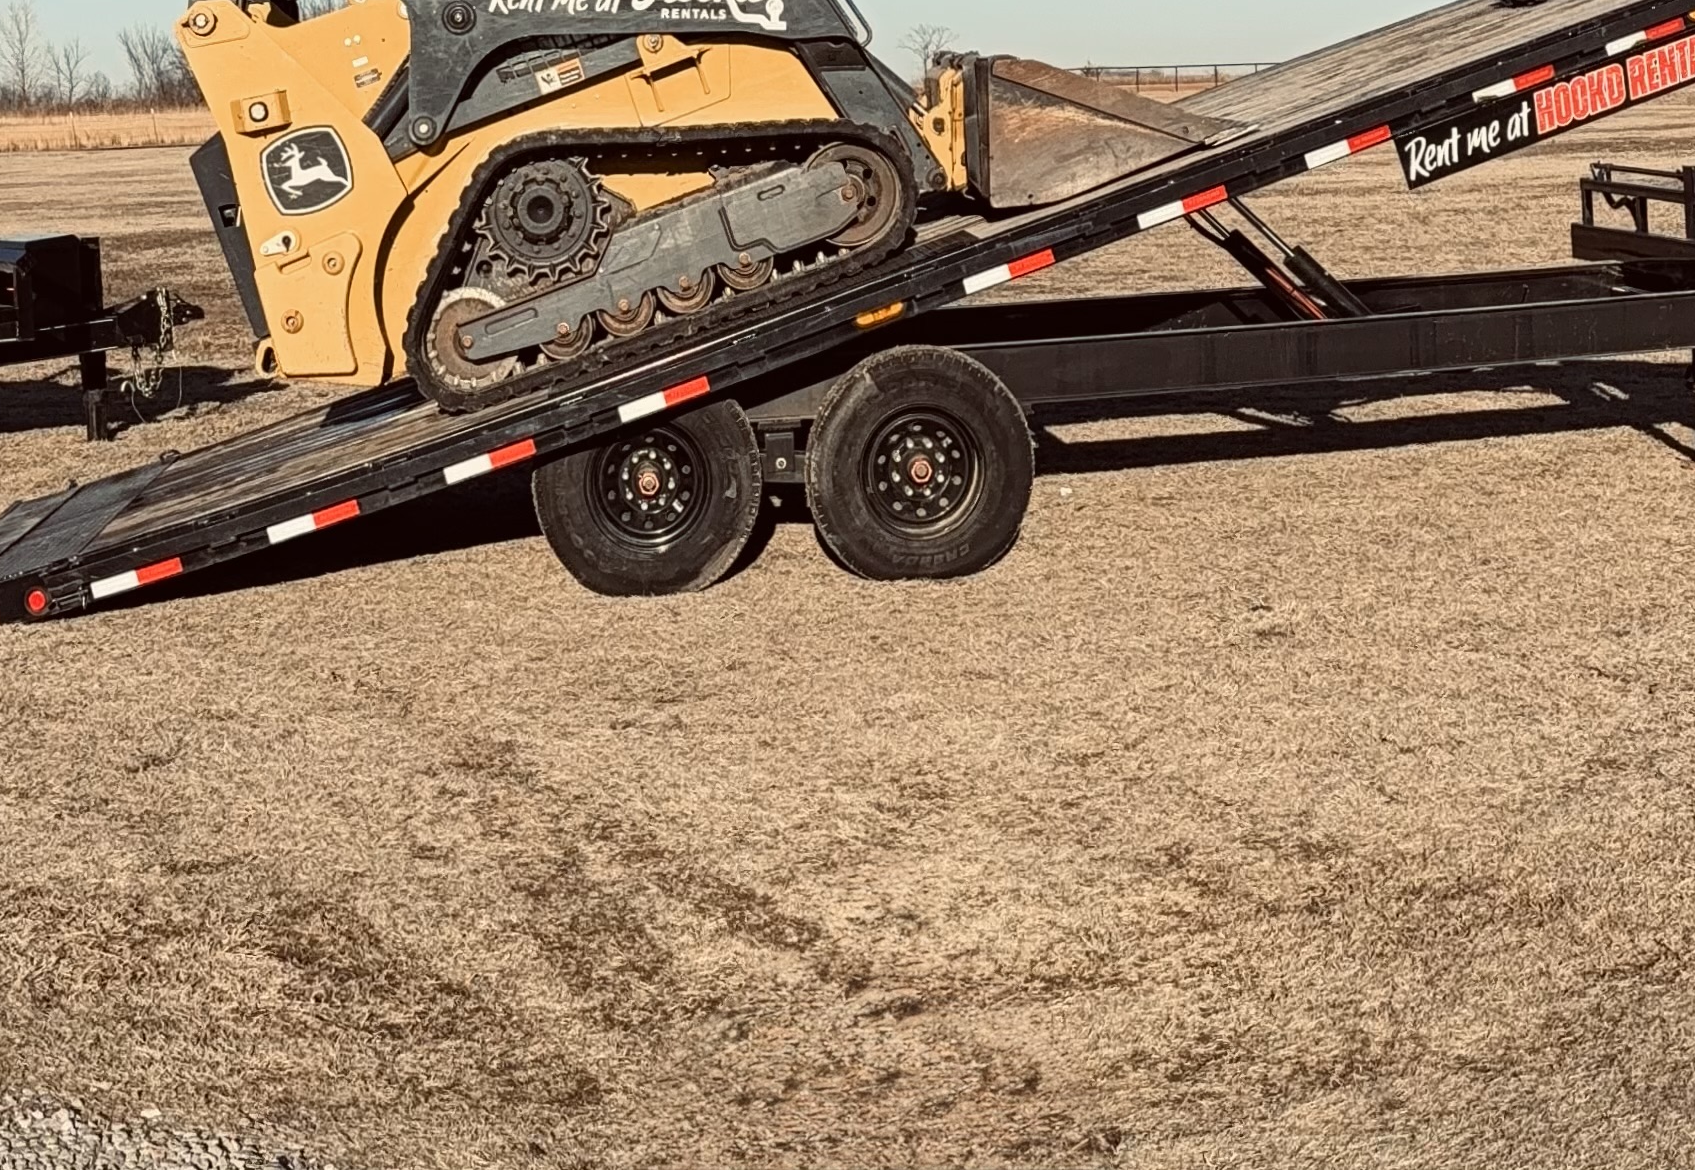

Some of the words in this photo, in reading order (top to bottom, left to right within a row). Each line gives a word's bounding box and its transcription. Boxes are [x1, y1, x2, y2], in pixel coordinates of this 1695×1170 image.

[660, 7, 727, 20] RENTALS
[1405, 127, 1460, 181] Rent
[1466, 119, 1501, 157] me
[1507, 101, 1532, 142] at
[1533, 63, 1626, 135] HOOKD
